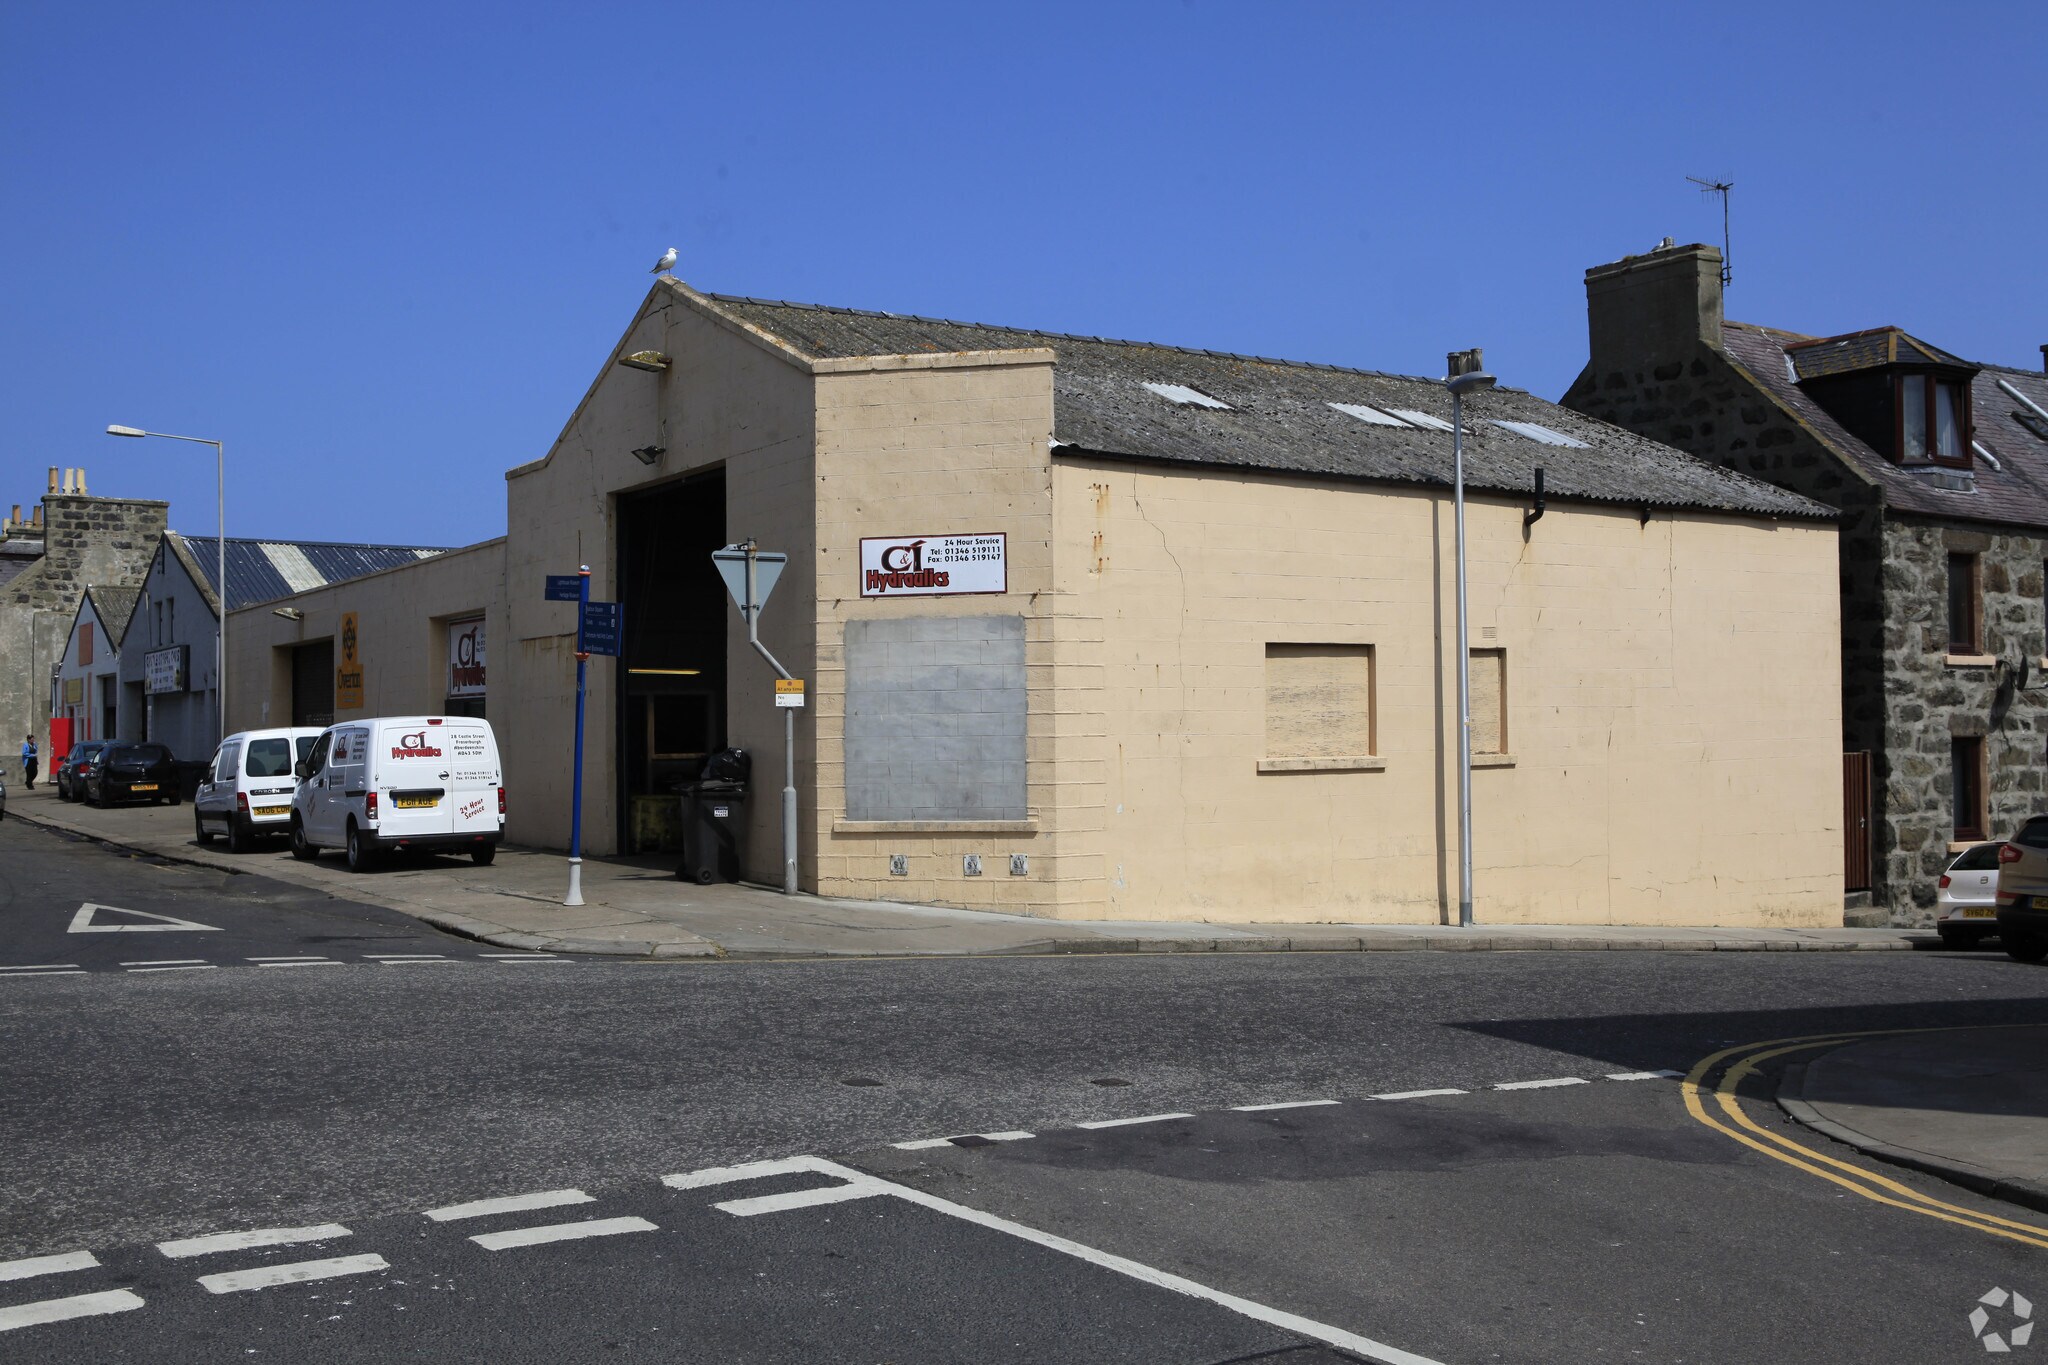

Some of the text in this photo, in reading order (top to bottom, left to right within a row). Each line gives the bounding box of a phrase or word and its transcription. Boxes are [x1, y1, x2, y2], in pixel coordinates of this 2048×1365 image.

[945, 547, 969, 555] 01346
[866, 568, 950, 592] Hydraulics
[392, 746, 442, 760] Hydraulics
[460, 798, 483, 814] 24 Hour
[464, 806, 485, 819] Service
